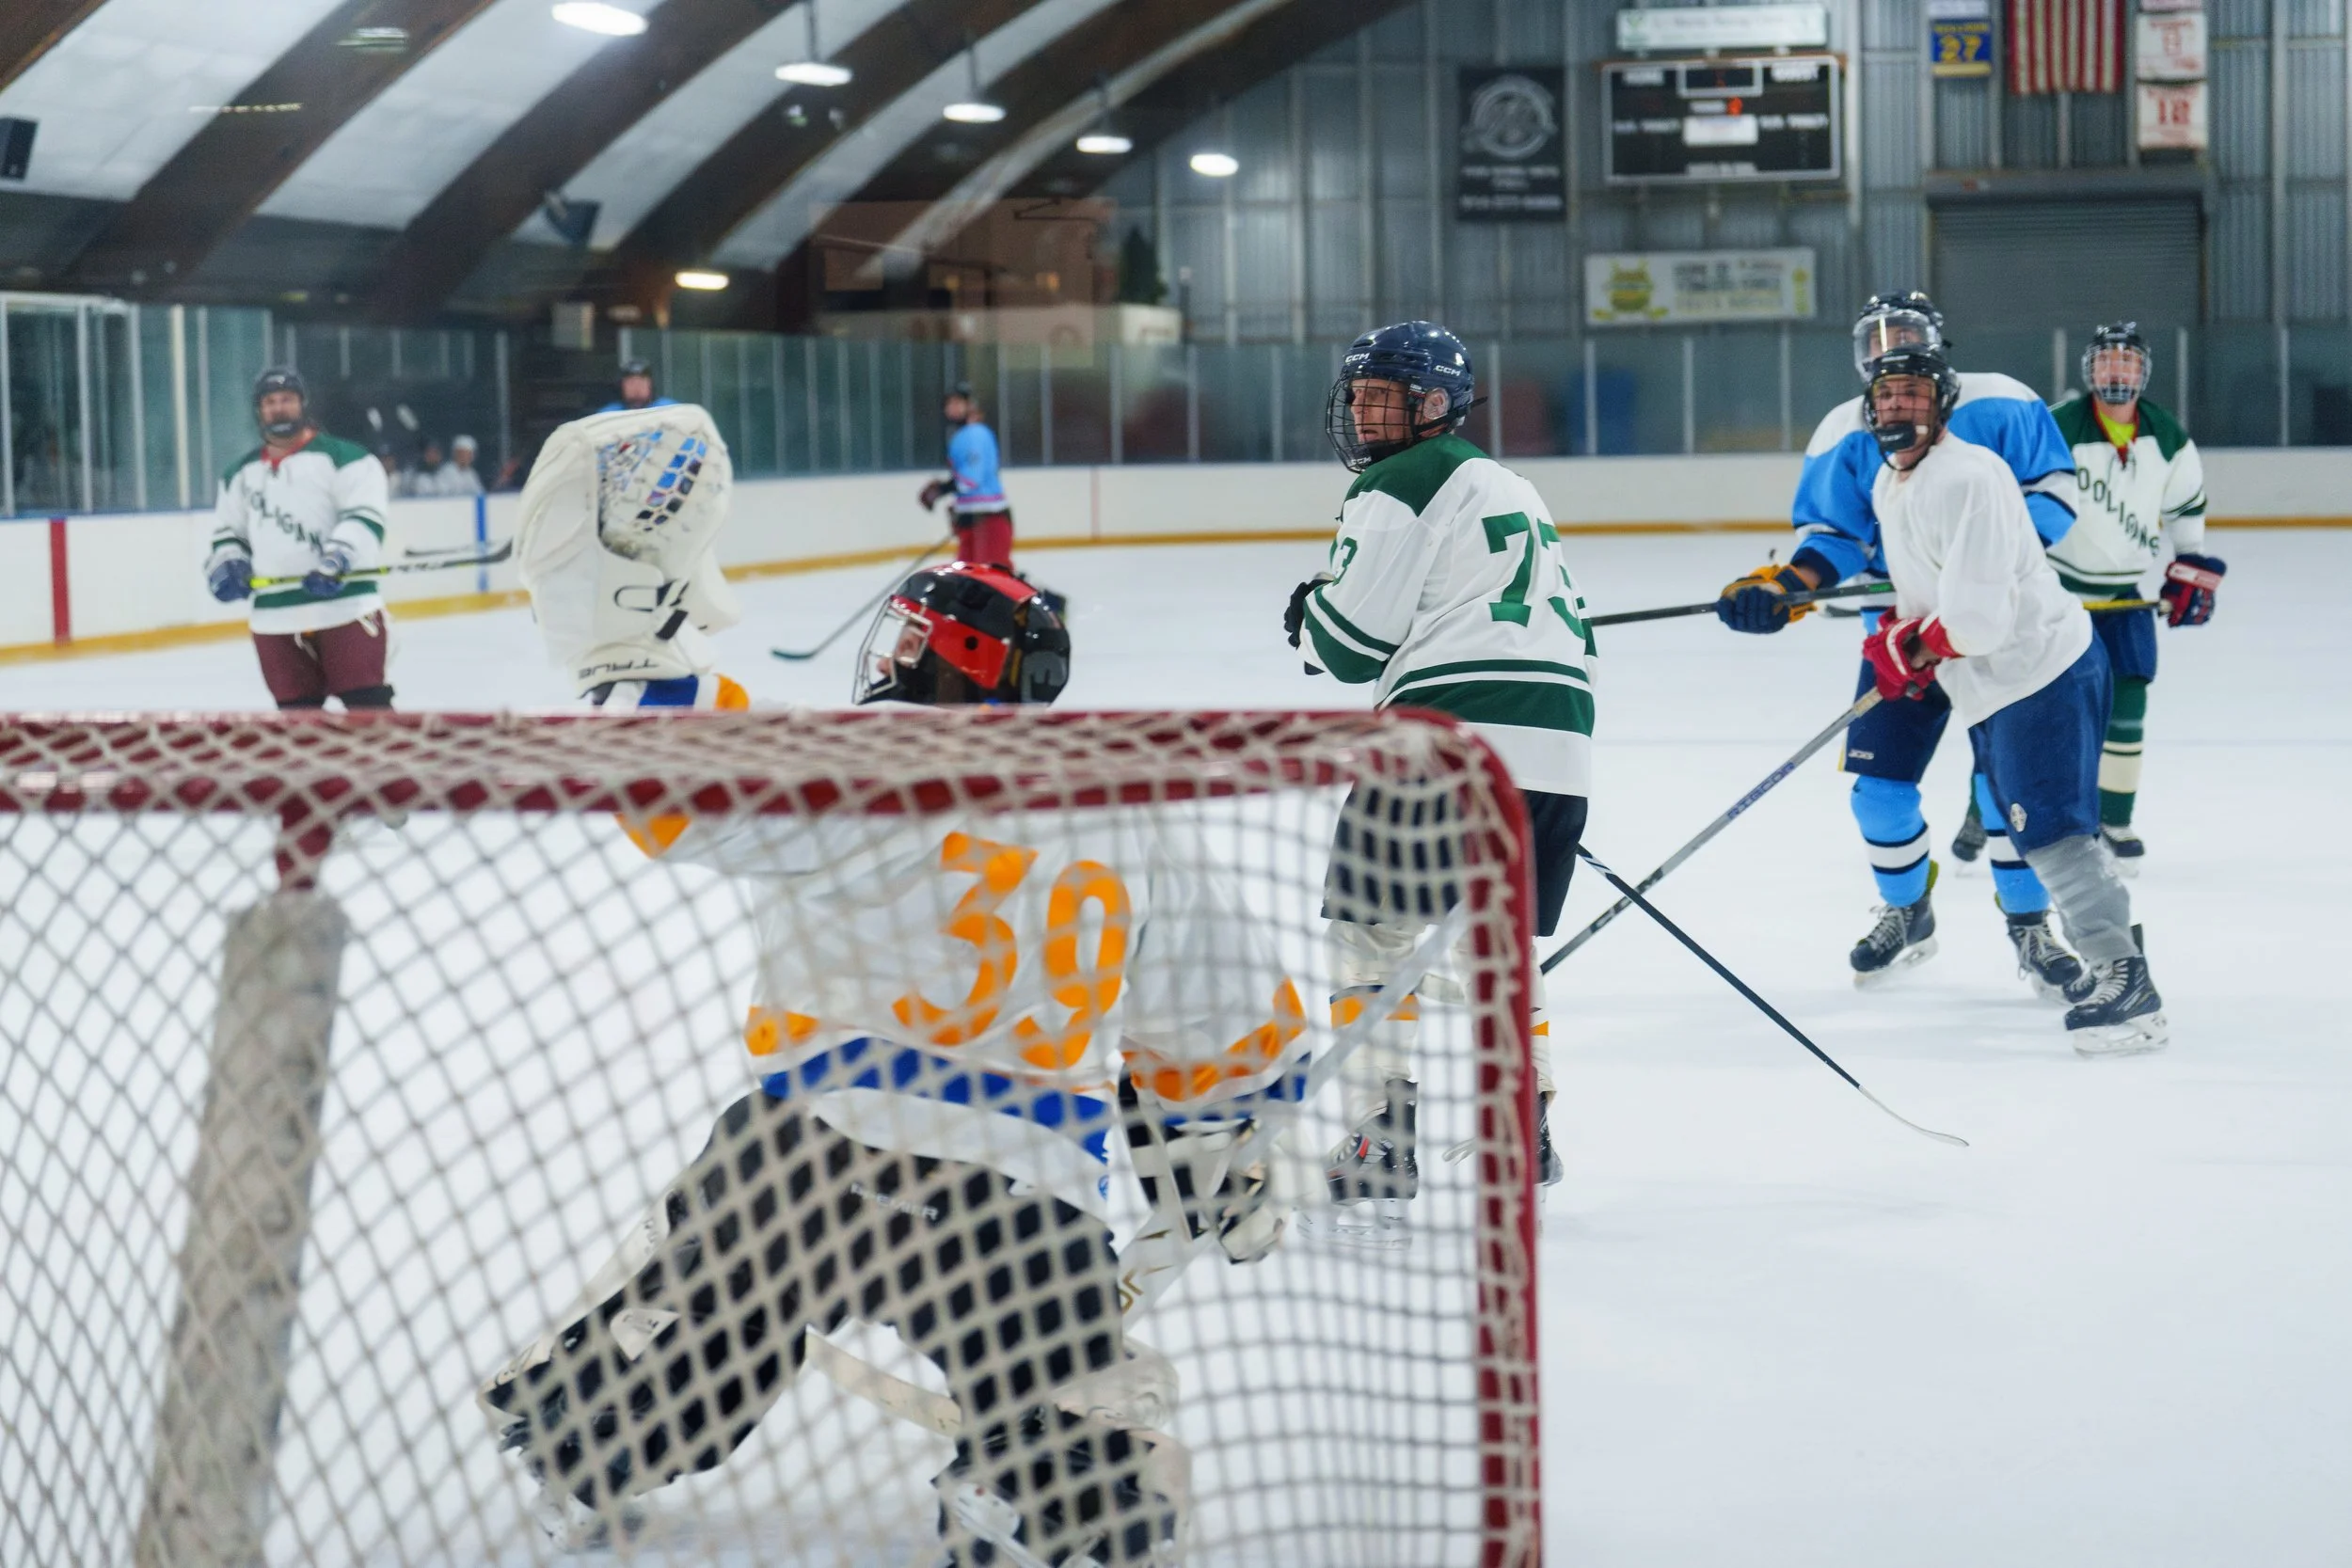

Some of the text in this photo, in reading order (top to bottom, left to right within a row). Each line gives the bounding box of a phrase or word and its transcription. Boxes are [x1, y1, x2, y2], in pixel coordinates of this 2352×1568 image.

[1344, 353, 1371, 363] CCM
[1435, 365, 1461, 376] CCM
[1351, 456, 1372, 465] CCM
[2076, 467, 2160, 558] OOLIGNS
[578, 658, 660, 679] TRUE
[891, 832, 1132, 1070] 39
[850, 1183, 939, 1221] PEMIR
